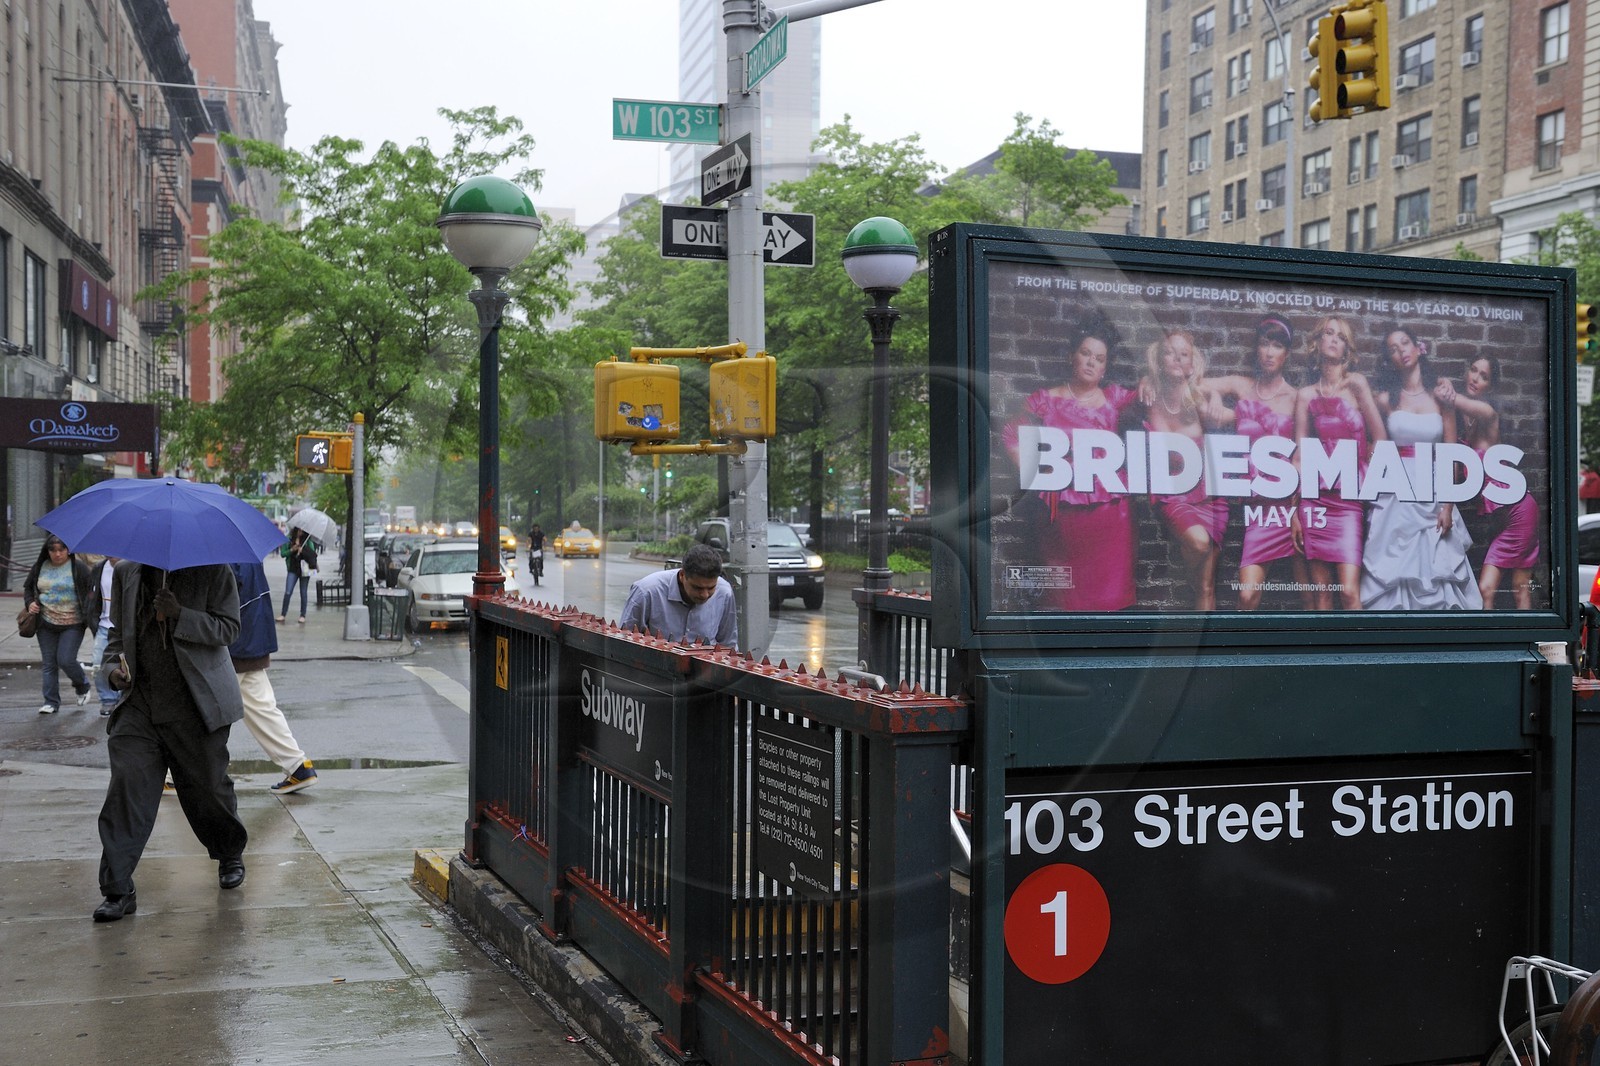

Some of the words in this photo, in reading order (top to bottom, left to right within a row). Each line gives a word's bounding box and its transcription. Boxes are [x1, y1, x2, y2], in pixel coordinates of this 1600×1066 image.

[749, 20, 786, 85] BROADWAY
[618, 104, 640, 135] W
[649, 106, 691, 138] 103
[694, 108, 715, 125] ST
[706, 167, 721, 190] ONE
[726, 154, 743, 181] WAY
[763, 229, 791, 249] AY
[1017, 276, 1051, 288] FROM
[1055, 278, 1077, 290] THE
[1081, 280, 1143, 295] PRODUCER
[1146, 286, 1162, 296] OF
[1166, 285, 1243, 303] SUPERBAD,
[1246, 290, 1312, 306] KNOCKED
[1316, 295, 1336, 310] UP,
[1339, 300, 1361, 310] AND
[1365, 299, 1389, 312] THE
[1392, 301, 1480, 318] 40-YEAR-OLD
[1483, 306, 1523, 321] VIRGIN
[1018, 425, 1528, 505] BRIDESMAIDS
[1244, 504, 1298, 527] MAY
[1303, 506, 1328, 529] 13
[1010, 568, 1021, 579] R
[1231, 581, 1345, 592] www.bridesmaidsmovie.com
[581, 668, 646, 752] Subway
[758, 738, 778, 755] Bicycles
[779, 747, 785, 756] or
[785, 748, 799, 761] other
[800, 753, 822, 771] property
[758, 771, 765, 784] be
[766, 776, 787, 792] removed
[787, 784, 797, 796] and
[798, 786, 821, 806] delivered
[822, 795, 828, 808] to
[759, 756, 779, 772] attached
[780, 763, 786, 774] to
[787, 765, 801, 780] these
[802, 771, 820, 788] railings
[821, 777, 830, 791] will
[758, 789, 767, 801] the
[767, 791, 778, 806] Lost
[779, 796, 800, 816] Property
[801, 804, 811, 819] Unit
[758, 804, 776, 822] located
[777, 813, 782, 824] at
[783, 814, 790, 828] 34
[791, 818, 797, 831] St
[798, 821, 803, 834] &
[804, 823, 809, 836] 8
[809, 825, 817, 839] Av
[1004, 797, 1104, 855] 103
[1133, 788, 1305, 849] Street
[1330, 781, 1514, 838] Station
[771, 825, 783, 843] (212)
[1040, 890, 1068, 957] 1
